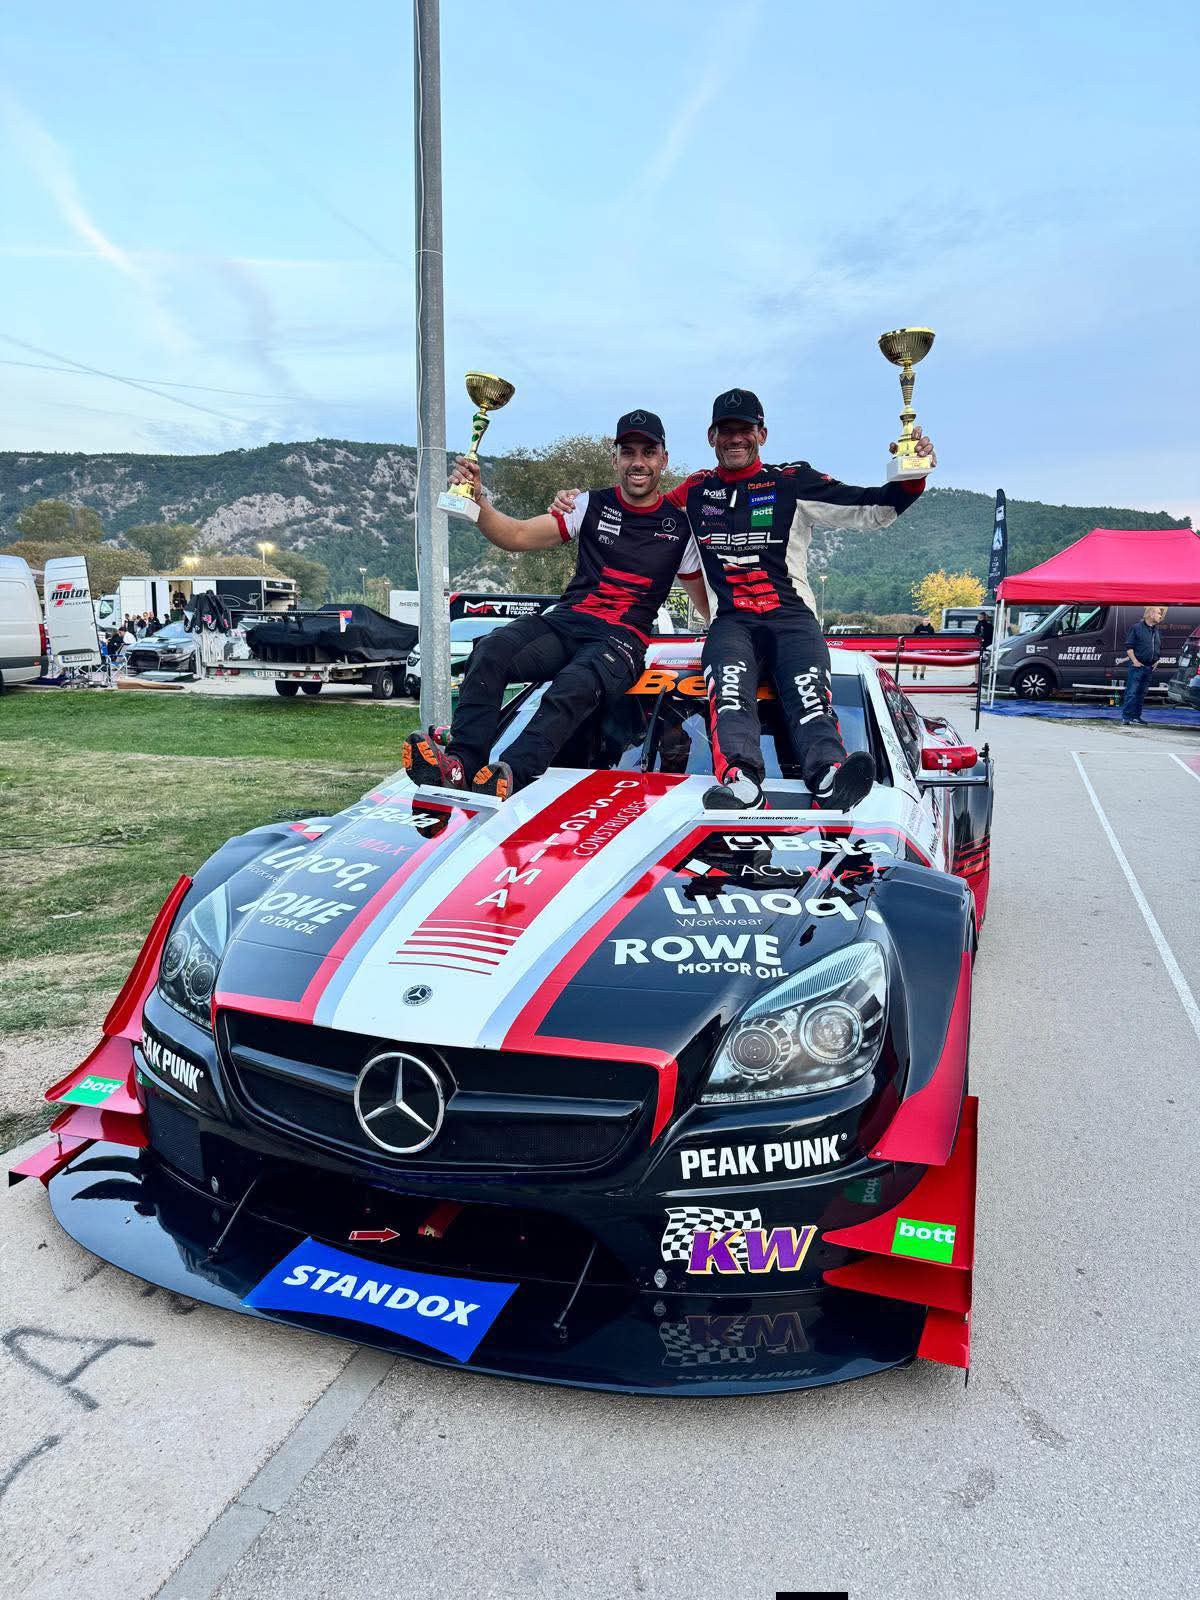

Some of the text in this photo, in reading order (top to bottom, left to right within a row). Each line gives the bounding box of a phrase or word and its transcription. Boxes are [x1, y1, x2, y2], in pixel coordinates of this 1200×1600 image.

[702, 488, 727, 497] ROWE
[51, 589, 89, 600] motor
[1058, 653, 1076, 661] RACE
[1081, 653, 1102, 661] RALLY
[372, 806, 441, 829] Beta
[768, 836, 894, 856] Beta
[294, 922, 320, 935] OIL
[675, 916, 763, 928] Workwear
[608, 934, 783, 966] ROWE
[677, 962, 790, 979] MOTOR OIL
[80, 1078, 121, 1095] bott
[680, 1144, 760, 1180] PEAK
[899, 1221, 956, 1244] bott
[685, 1225, 819, 1275] KW
[282, 1264, 481, 1327] STANDOX
